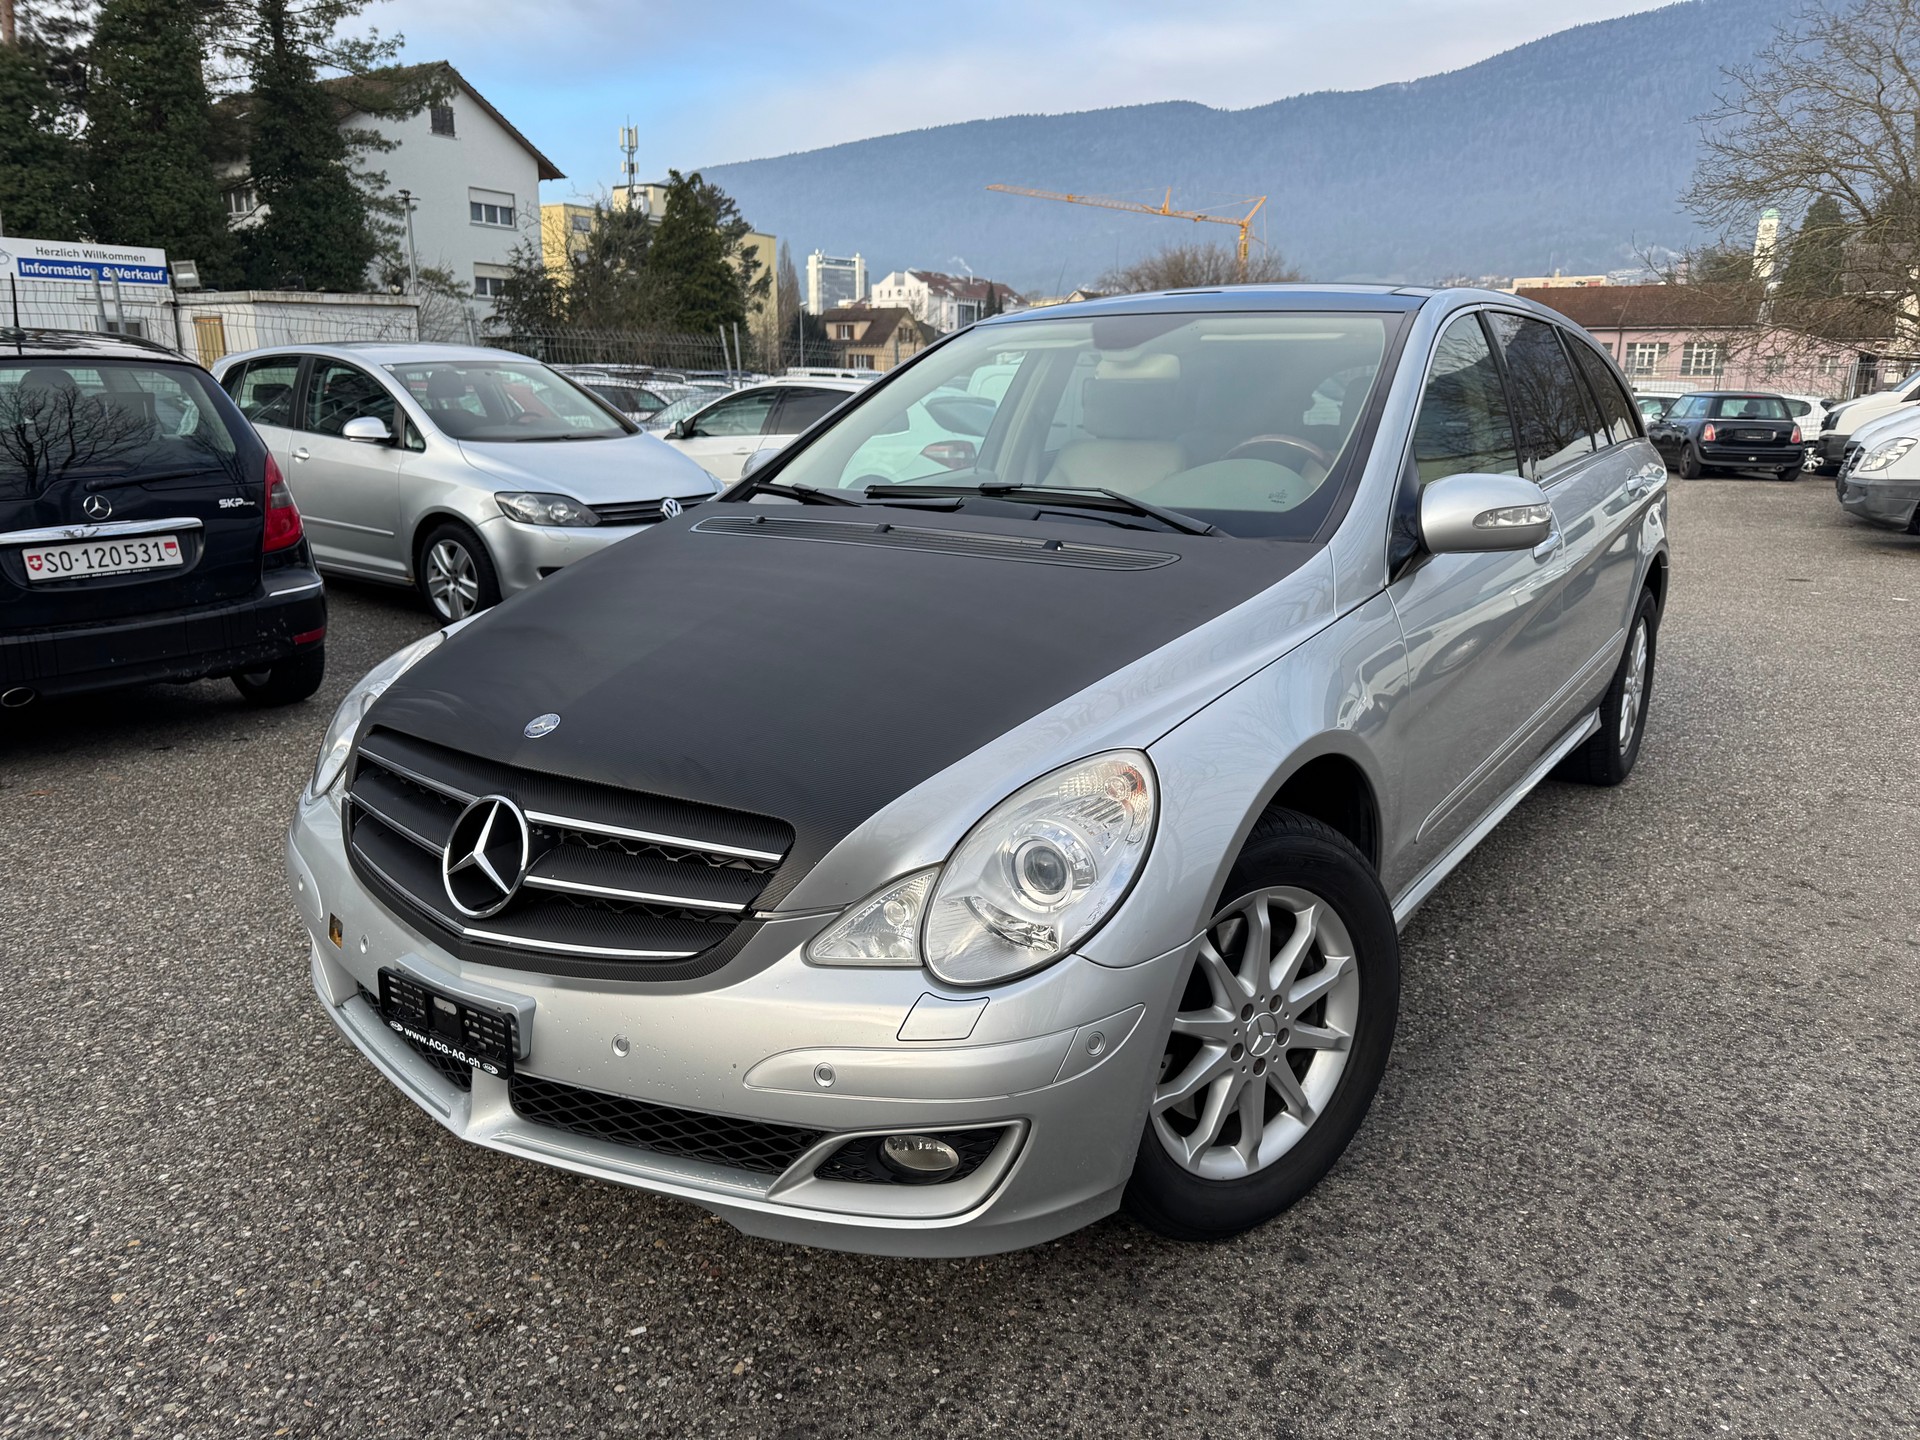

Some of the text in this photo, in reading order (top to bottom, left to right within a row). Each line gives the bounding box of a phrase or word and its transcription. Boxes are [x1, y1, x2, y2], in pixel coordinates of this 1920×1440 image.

[35, 246, 146, 263] Herzlich Willkommen
[21, 261, 163, 281] Informatio & Verkauf
[218, 497, 244, 509] SKP
[404, 1027, 481, 1069] www.ACG-AG.ch
